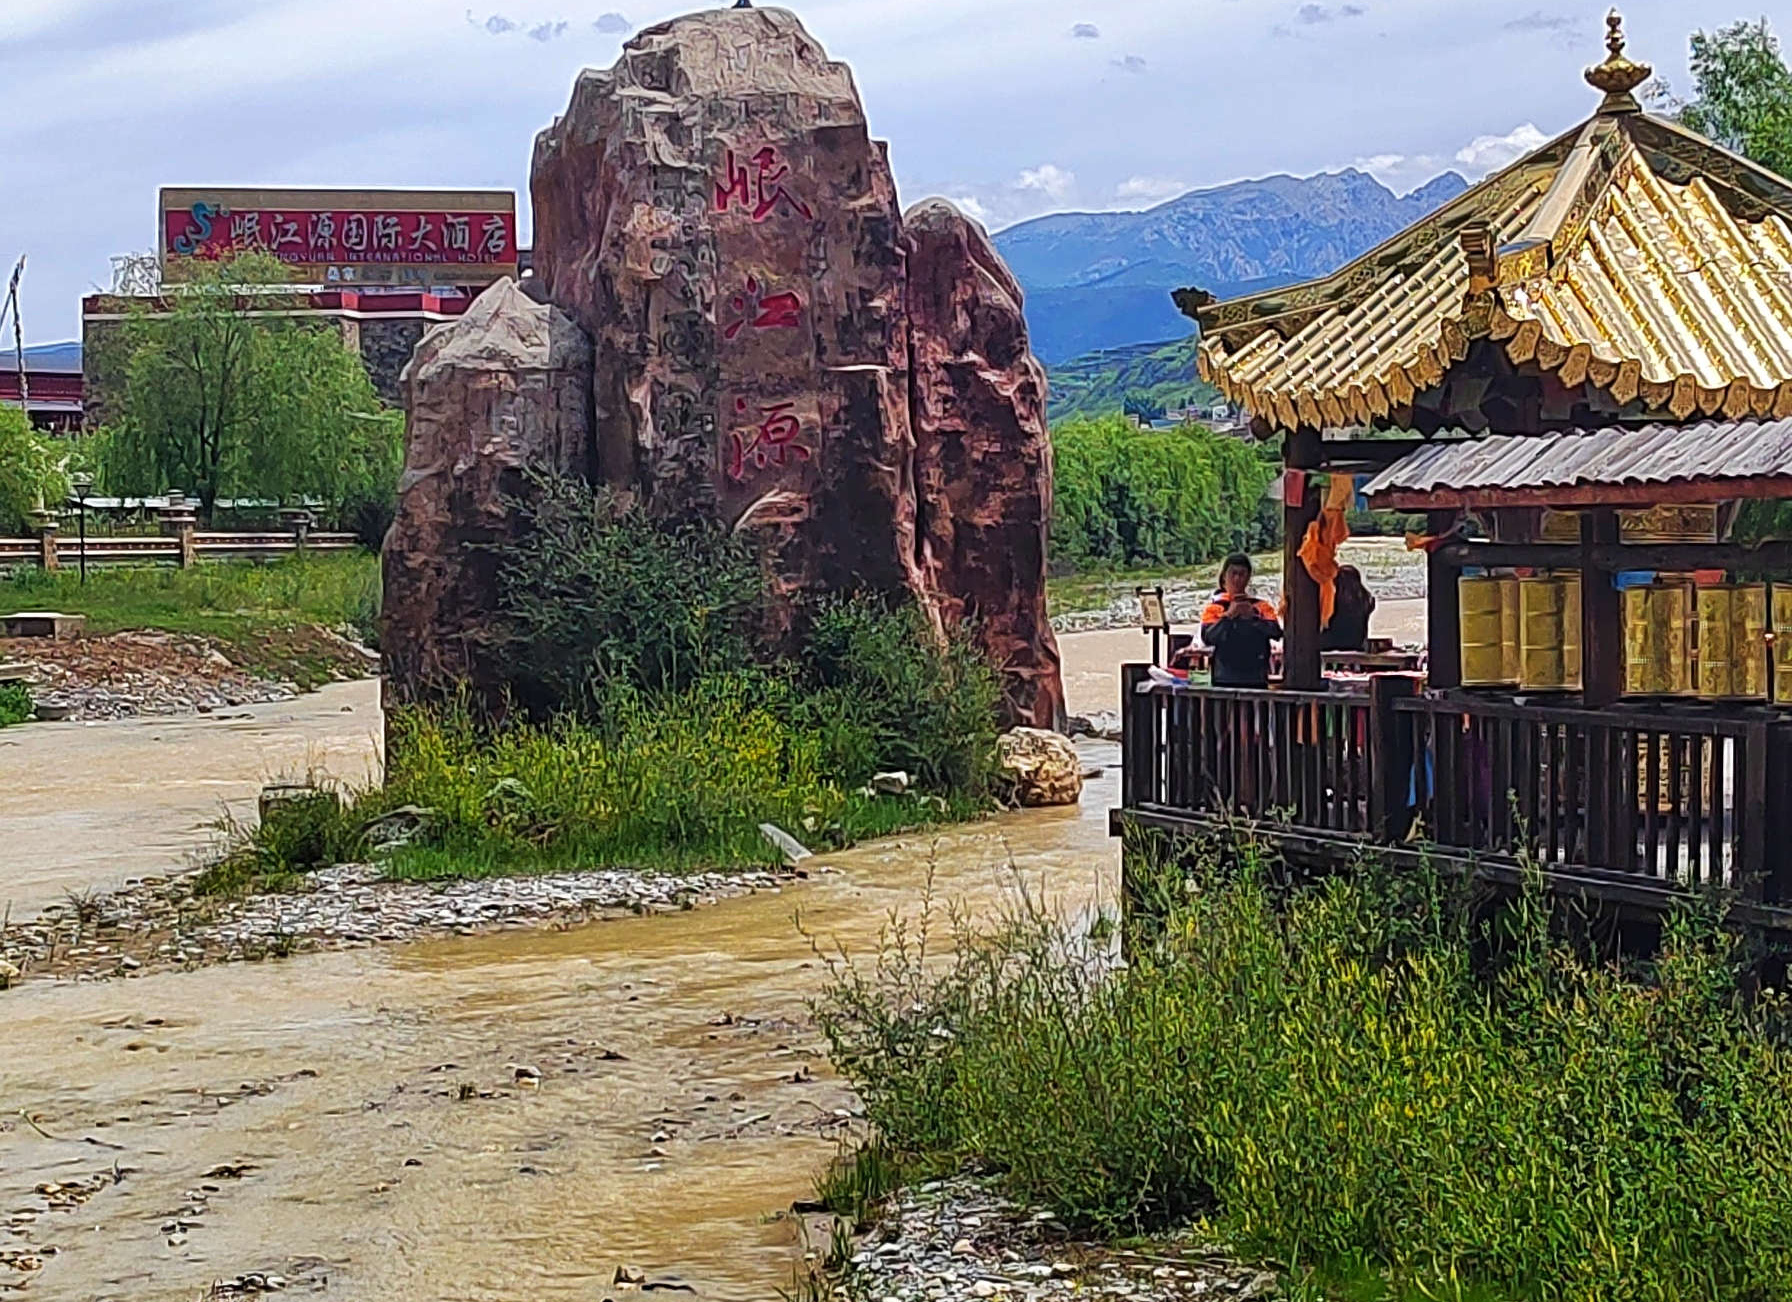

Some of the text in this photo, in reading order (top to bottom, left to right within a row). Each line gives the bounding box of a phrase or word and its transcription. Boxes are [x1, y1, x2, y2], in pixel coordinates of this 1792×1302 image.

[230, 211, 507, 254] 岷江源国际大酒店
[458, 253, 497, 263] HOTEL
[715, 145, 813, 479] 岷江源
